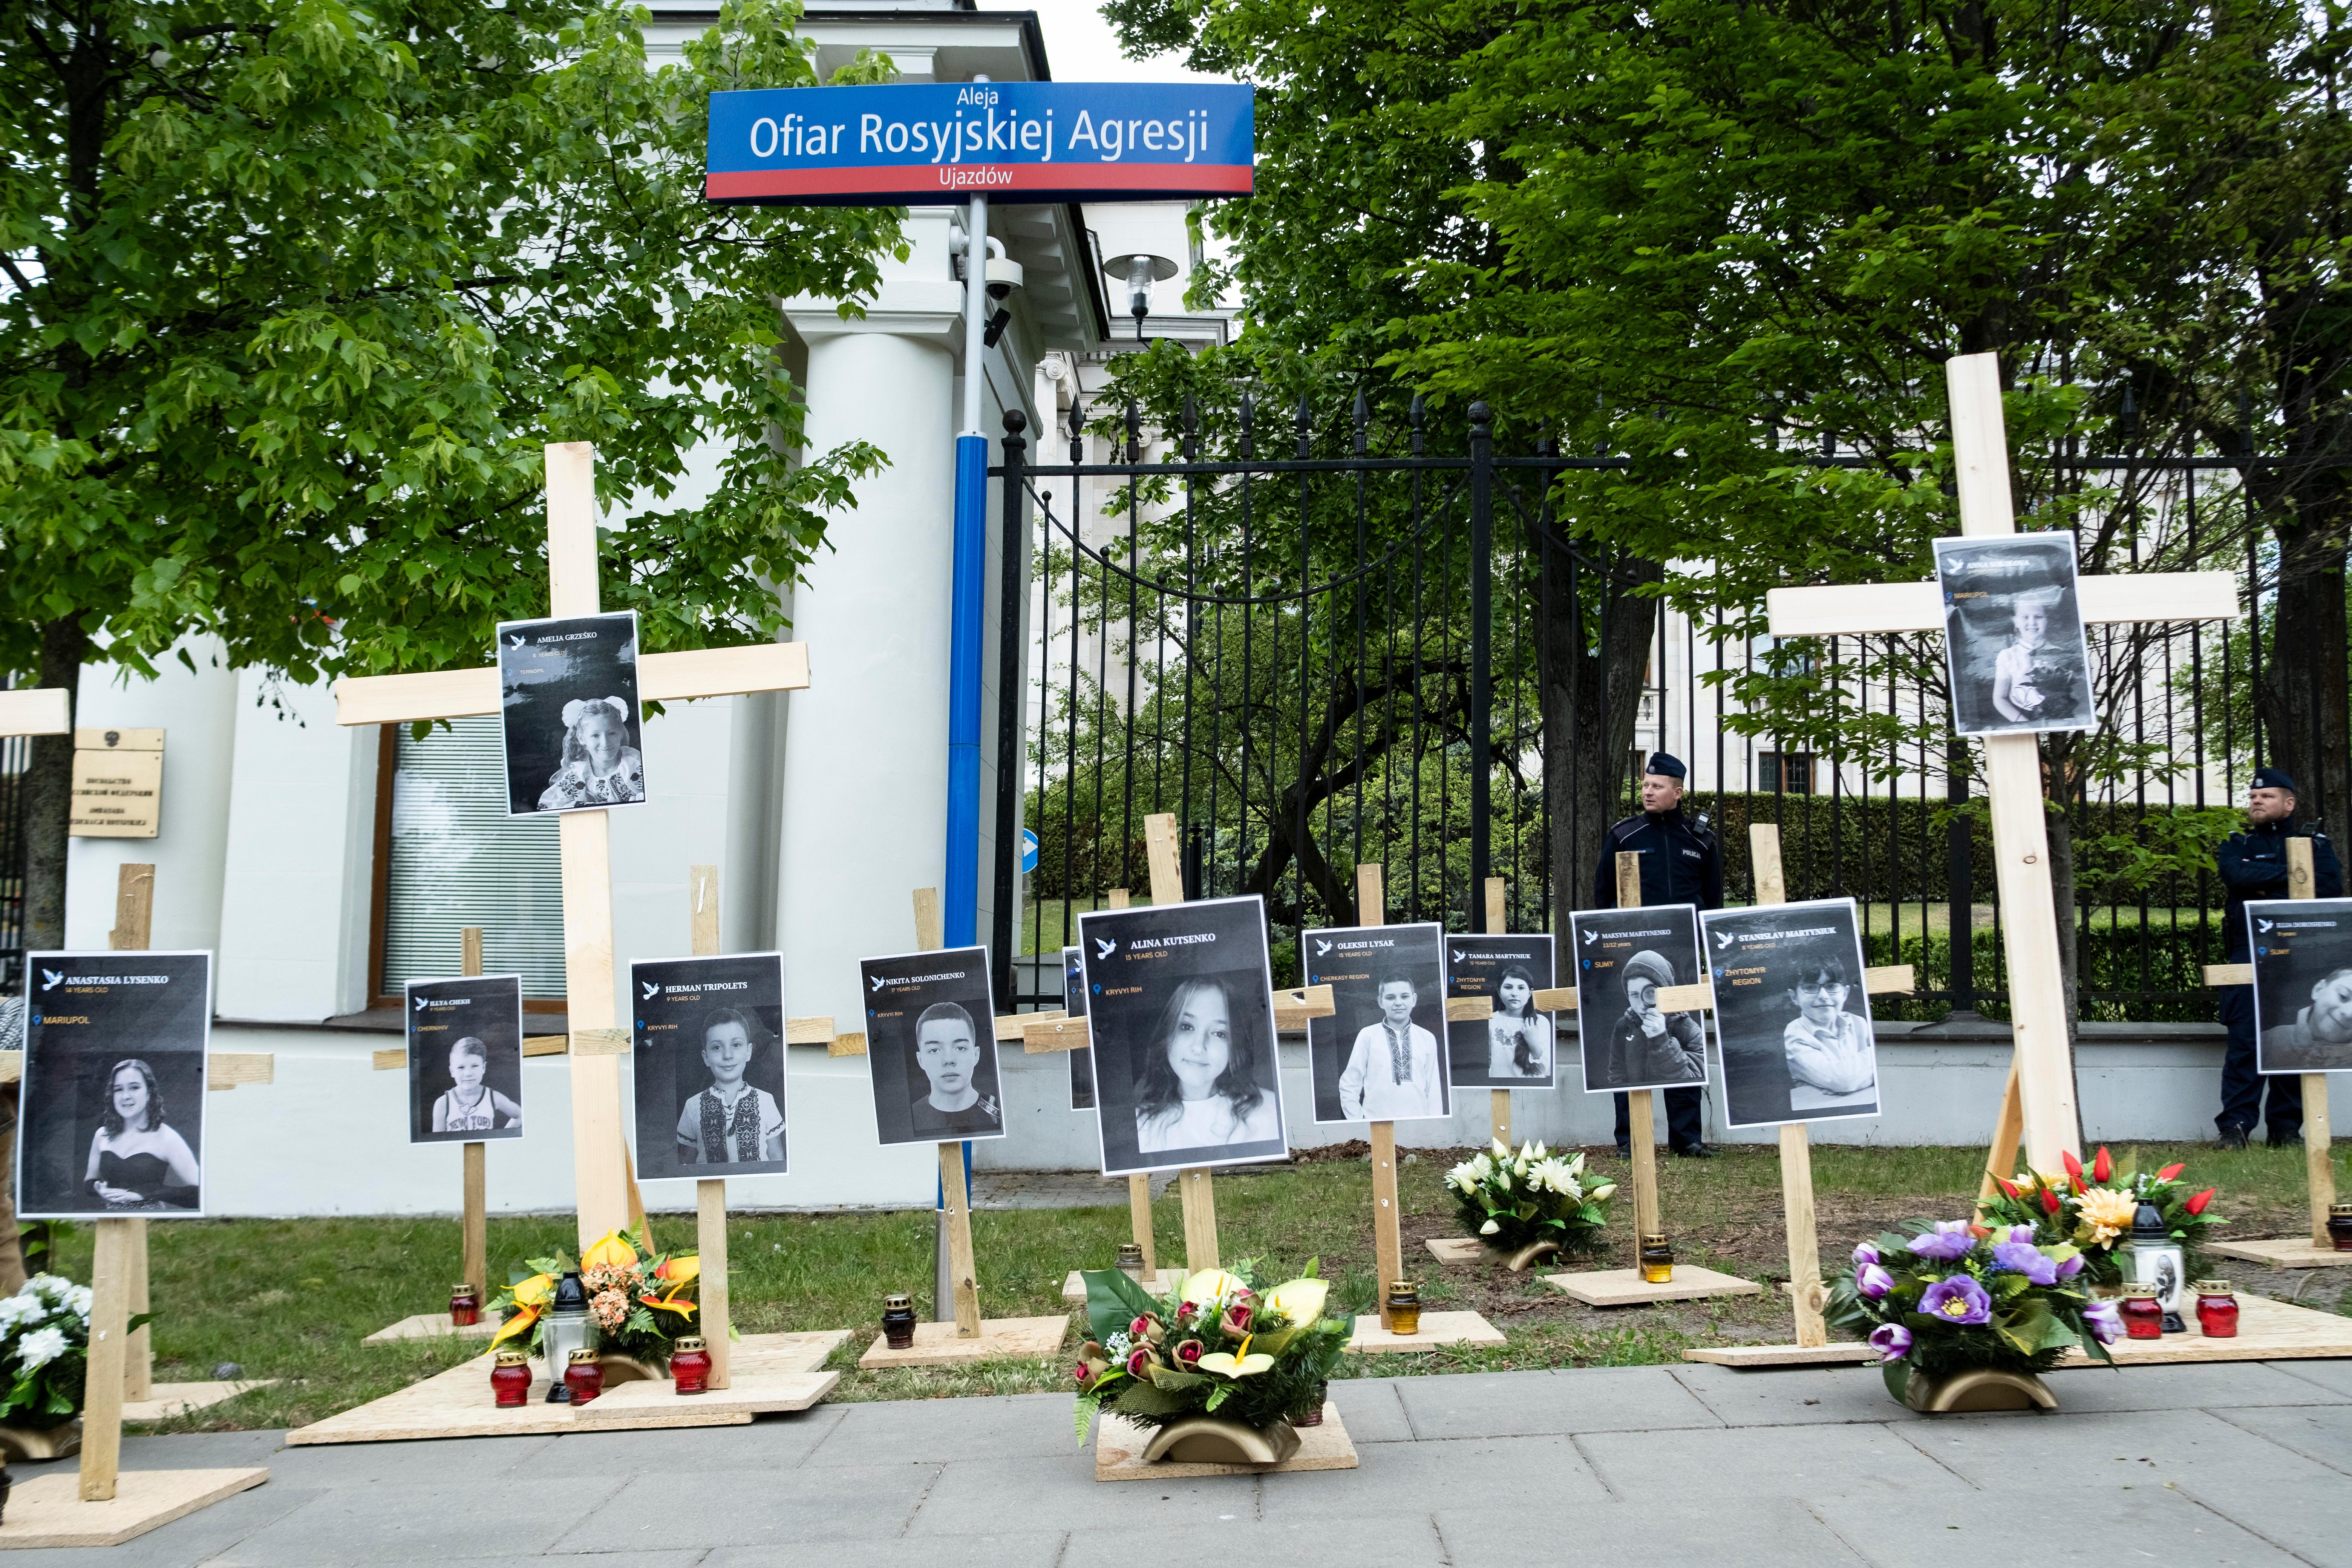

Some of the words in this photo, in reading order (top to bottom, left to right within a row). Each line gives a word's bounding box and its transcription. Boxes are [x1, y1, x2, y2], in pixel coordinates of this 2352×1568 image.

[957, 88, 998, 107] Aleja
[750, 113, 844, 157] Ofiar
[861, 109, 1052, 163] Rosyjskiej
[1069, 110, 1207, 162] Agresji
[939, 167, 1012, 189] Ujazdów
[565, 632, 597, 640] GRZEŚKO
[1683, 850, 1701, 859] POLICJA
[1738, 932, 1785, 942] STANISLAV
[1785, 927, 1837, 937] MARTYNIUK
[1131, 939, 1161, 949] ALINA
[1163, 933, 1216, 946] KUTSENKO
[1369, 940, 1394, 948] LYSAK
[1725, 967, 1766, 976] ZHYTOMYR
[65, 976, 122, 985] ANASTASIA
[124, 975, 169, 984] LYSENKO
[911, 972, 965, 983] SOLONICHENKO
[665, 984, 701, 993] HERMAN
[703, 982, 747, 991] TRIPOLETS
[43, 1016, 90, 1024] MARIUPOL
